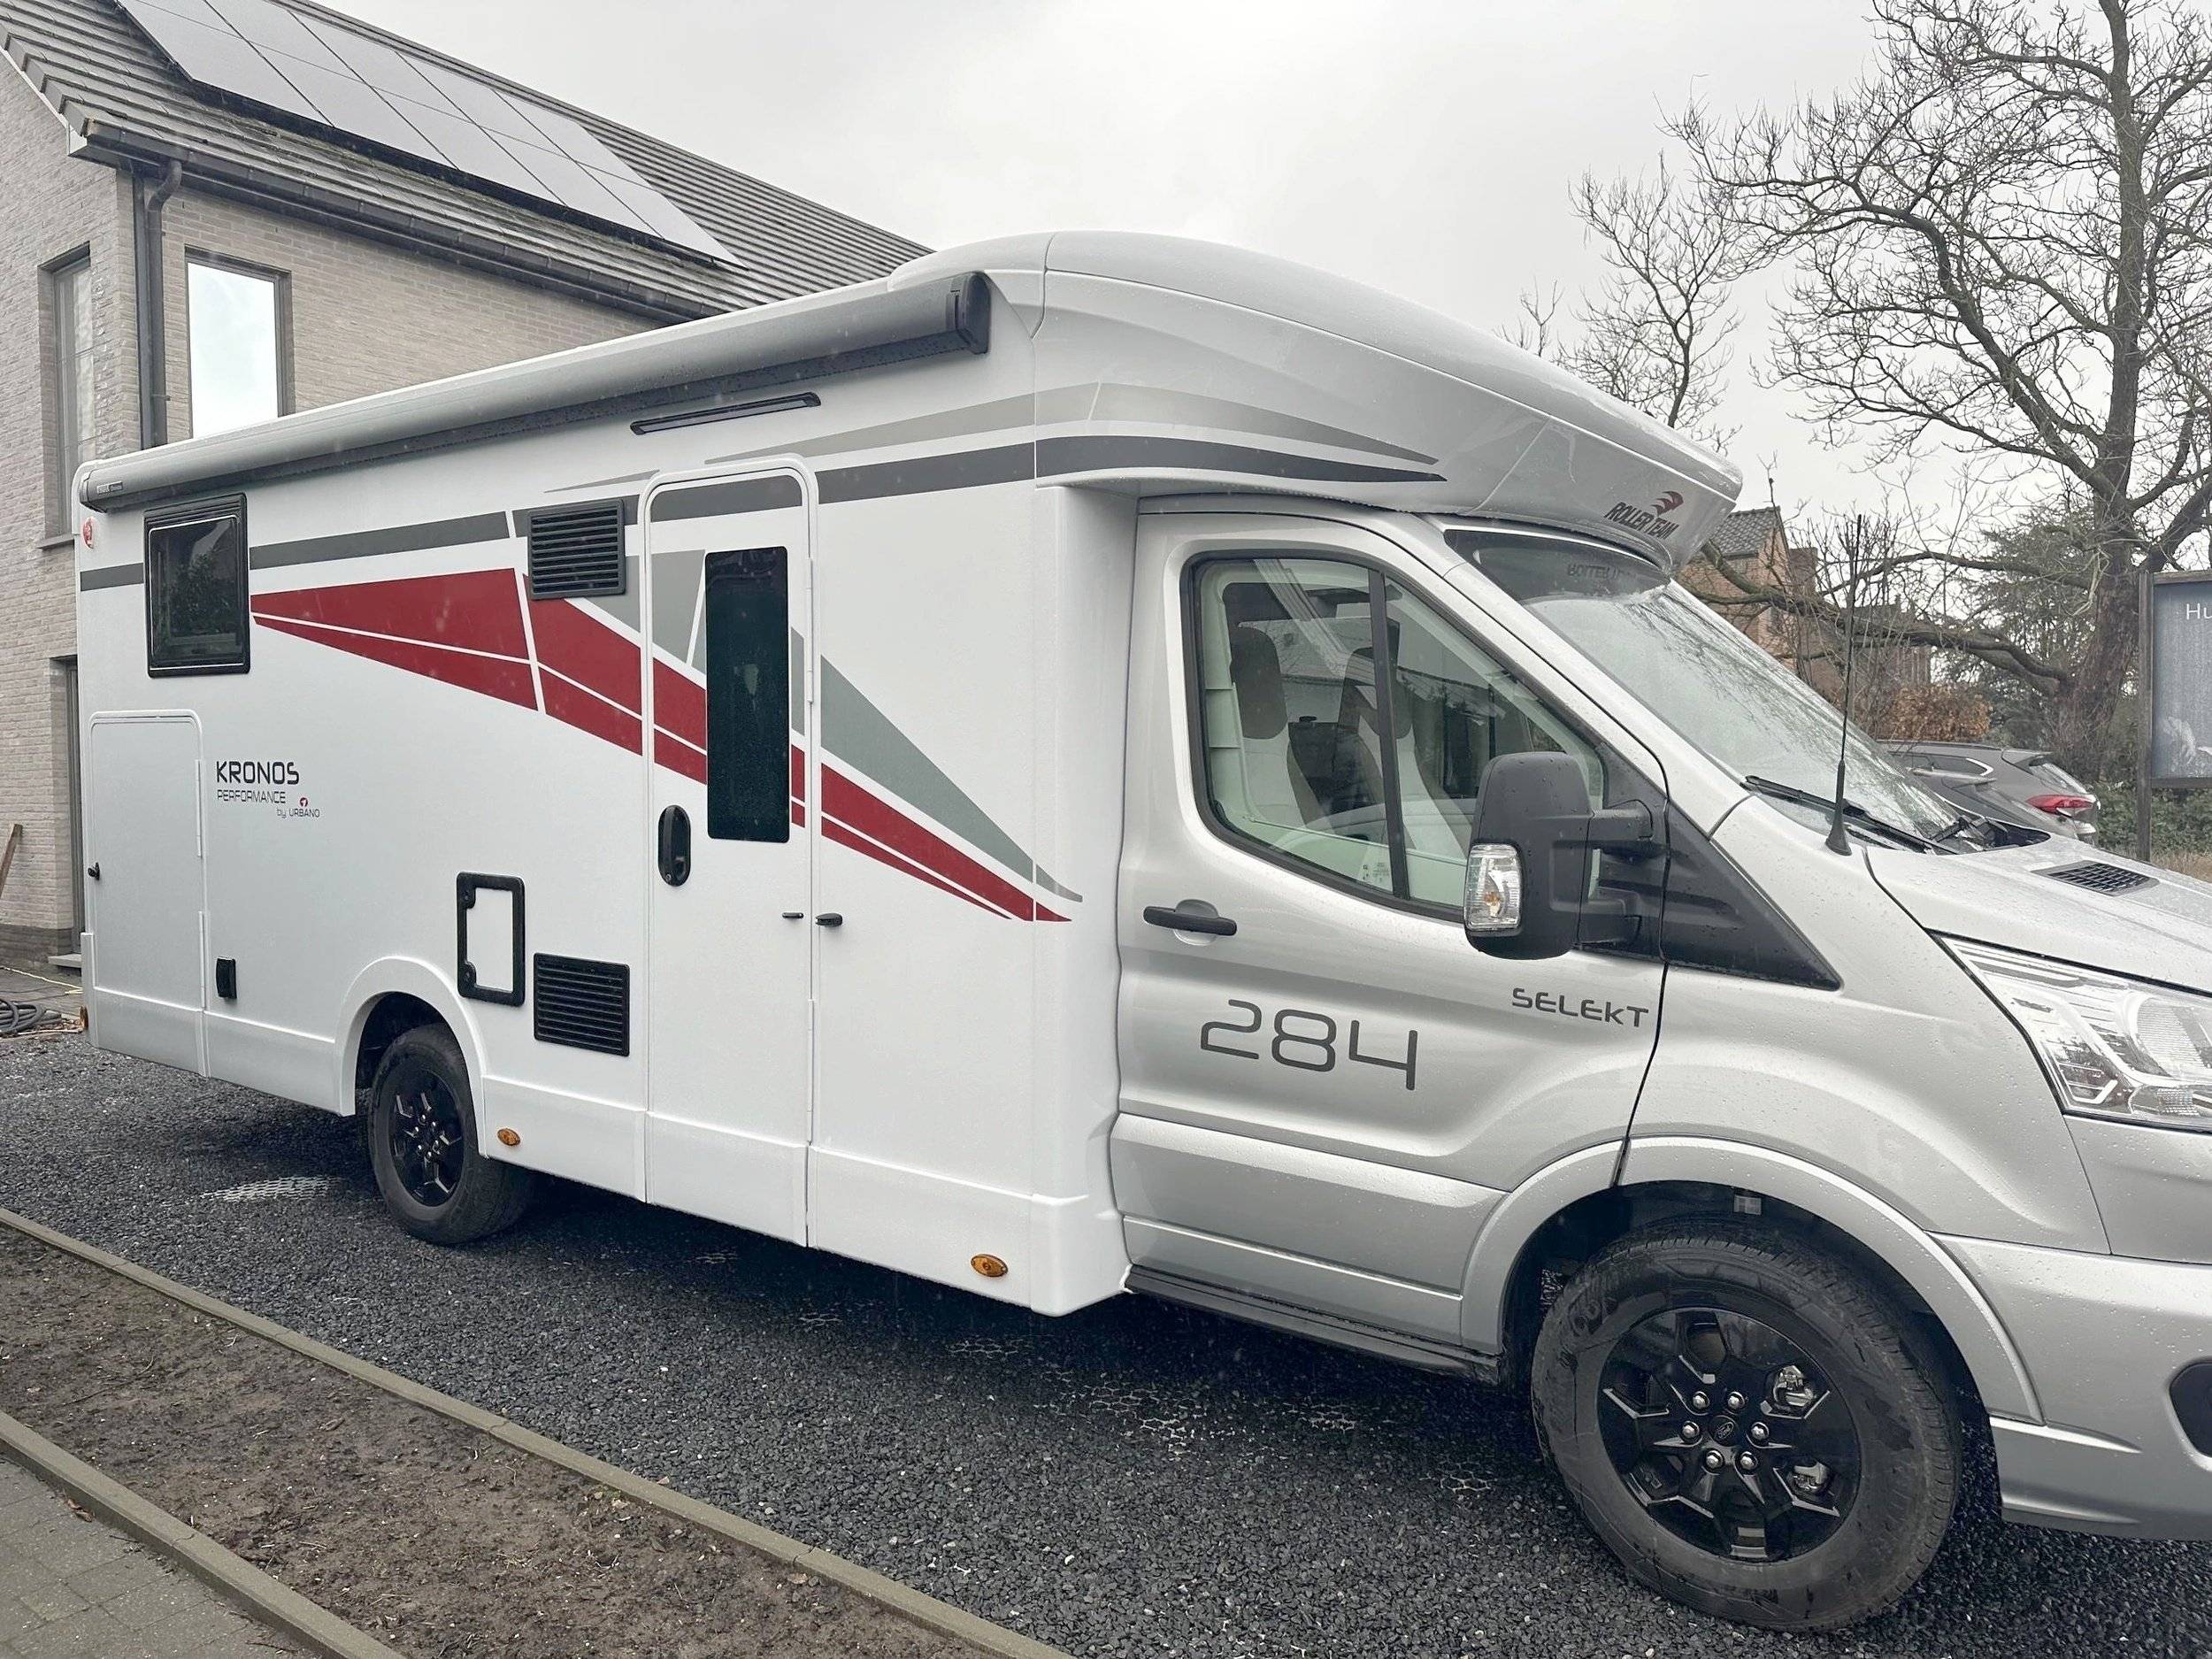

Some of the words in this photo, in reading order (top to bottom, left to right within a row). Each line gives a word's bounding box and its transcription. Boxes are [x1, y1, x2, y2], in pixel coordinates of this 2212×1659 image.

[1603, 501, 1655, 532] ROLLER
[1643, 517, 1680, 540] TEAM
[216, 761, 300, 785] KRONOS
[217, 789, 286, 804] PERFORMANCE
[276, 808, 288, 818] by
[288, 808, 320, 818] URBANO
[1511, 987, 1649, 1028] SELEKT
[1200, 998, 1418, 1091] 284
